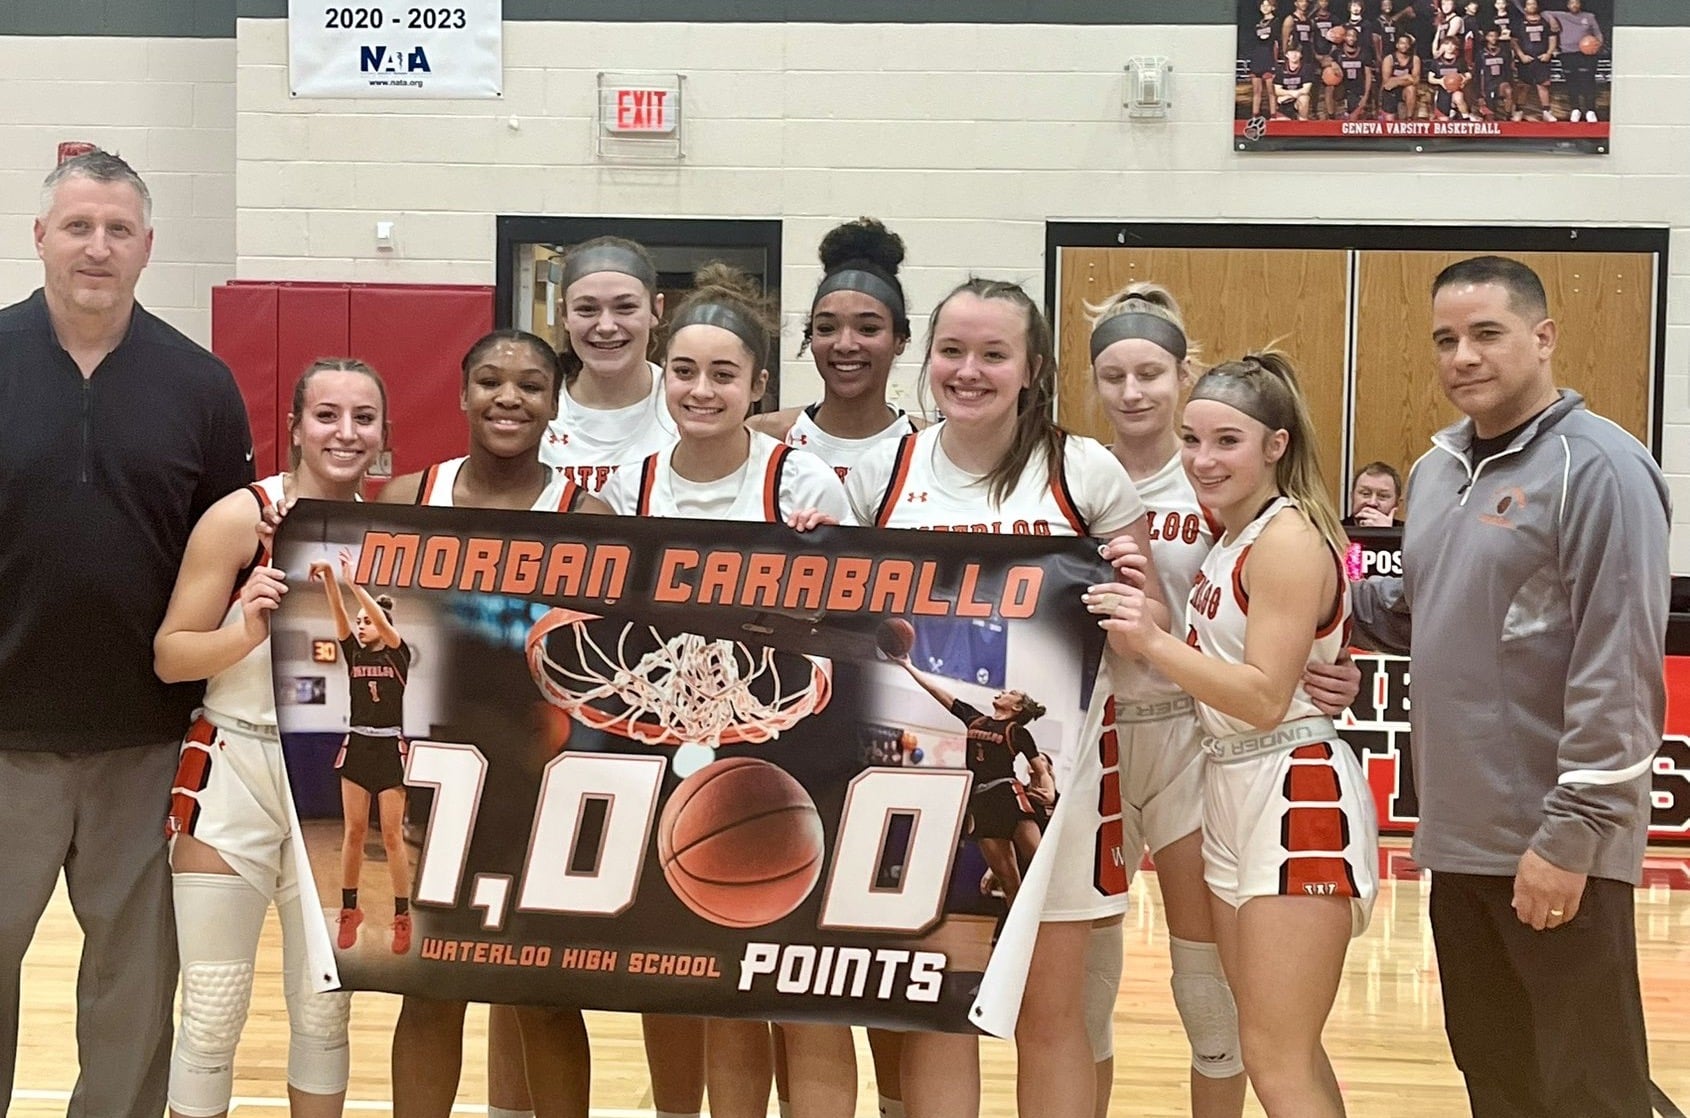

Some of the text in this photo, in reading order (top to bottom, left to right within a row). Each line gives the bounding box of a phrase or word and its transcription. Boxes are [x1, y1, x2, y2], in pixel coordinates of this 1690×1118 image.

[325, 8, 383, 29] 2020
[407, 8, 467, 29] 2023
[369, 79, 424, 88] www.nata.org
[617, 90, 666, 129] EXIT
[1341, 122, 1501, 135] GENEVA VARSITY BASKETBALL
[354, 530, 1045, 619] MORGAN CARABALLO
[314, 641, 336, 661] 30
[368, 680, 380, 702] 1
[421, 937, 721, 979] WATERLOO HIGH SCHOOL
[737, 941, 948, 1003] POINTS
